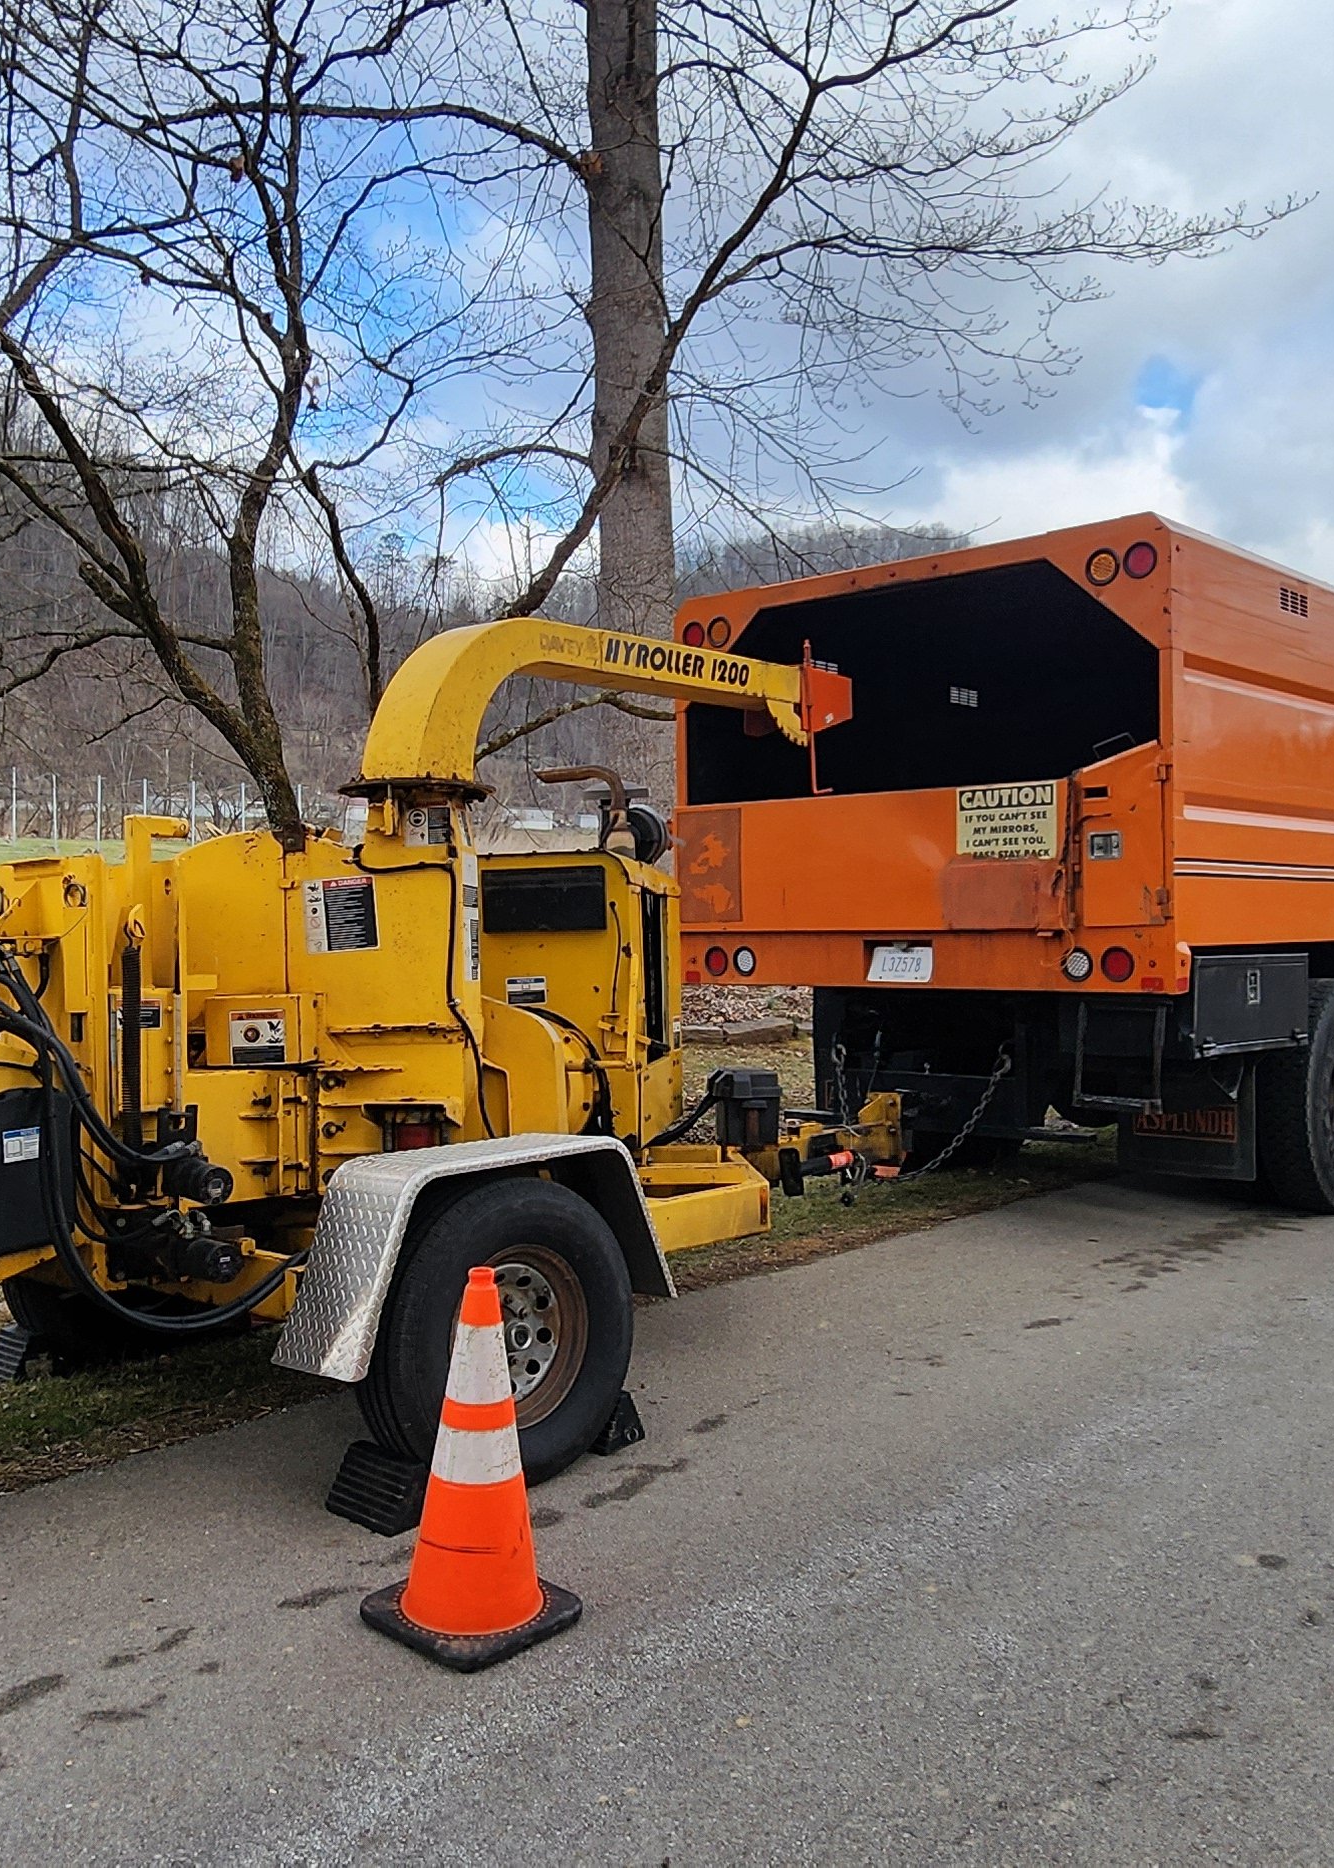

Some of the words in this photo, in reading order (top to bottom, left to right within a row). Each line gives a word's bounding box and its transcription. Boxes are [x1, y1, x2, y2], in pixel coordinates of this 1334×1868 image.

[604, 637, 705, 680] HYROLLER
[710, 657, 750, 687] 1200
[961, 786, 1052, 809] CAUTION
[965, 815, 973, 823] IF
[976, 813, 995, 822] YOU
[999, 811, 1027, 820] CAN'T
[1030, 810, 1047, 819] SEE
[972, 826, 986, 835] MY
[990, 823, 1039, 834] MIRRORS,
[966, 839, 969, 848] I
[972, 837, 999, 847] CAN'T
[1002, 837, 1019, 846] SEE
[1022, 836, 1046, 845] YOU.
[1137, 1110, 1235, 1136] ASPLUNDH
